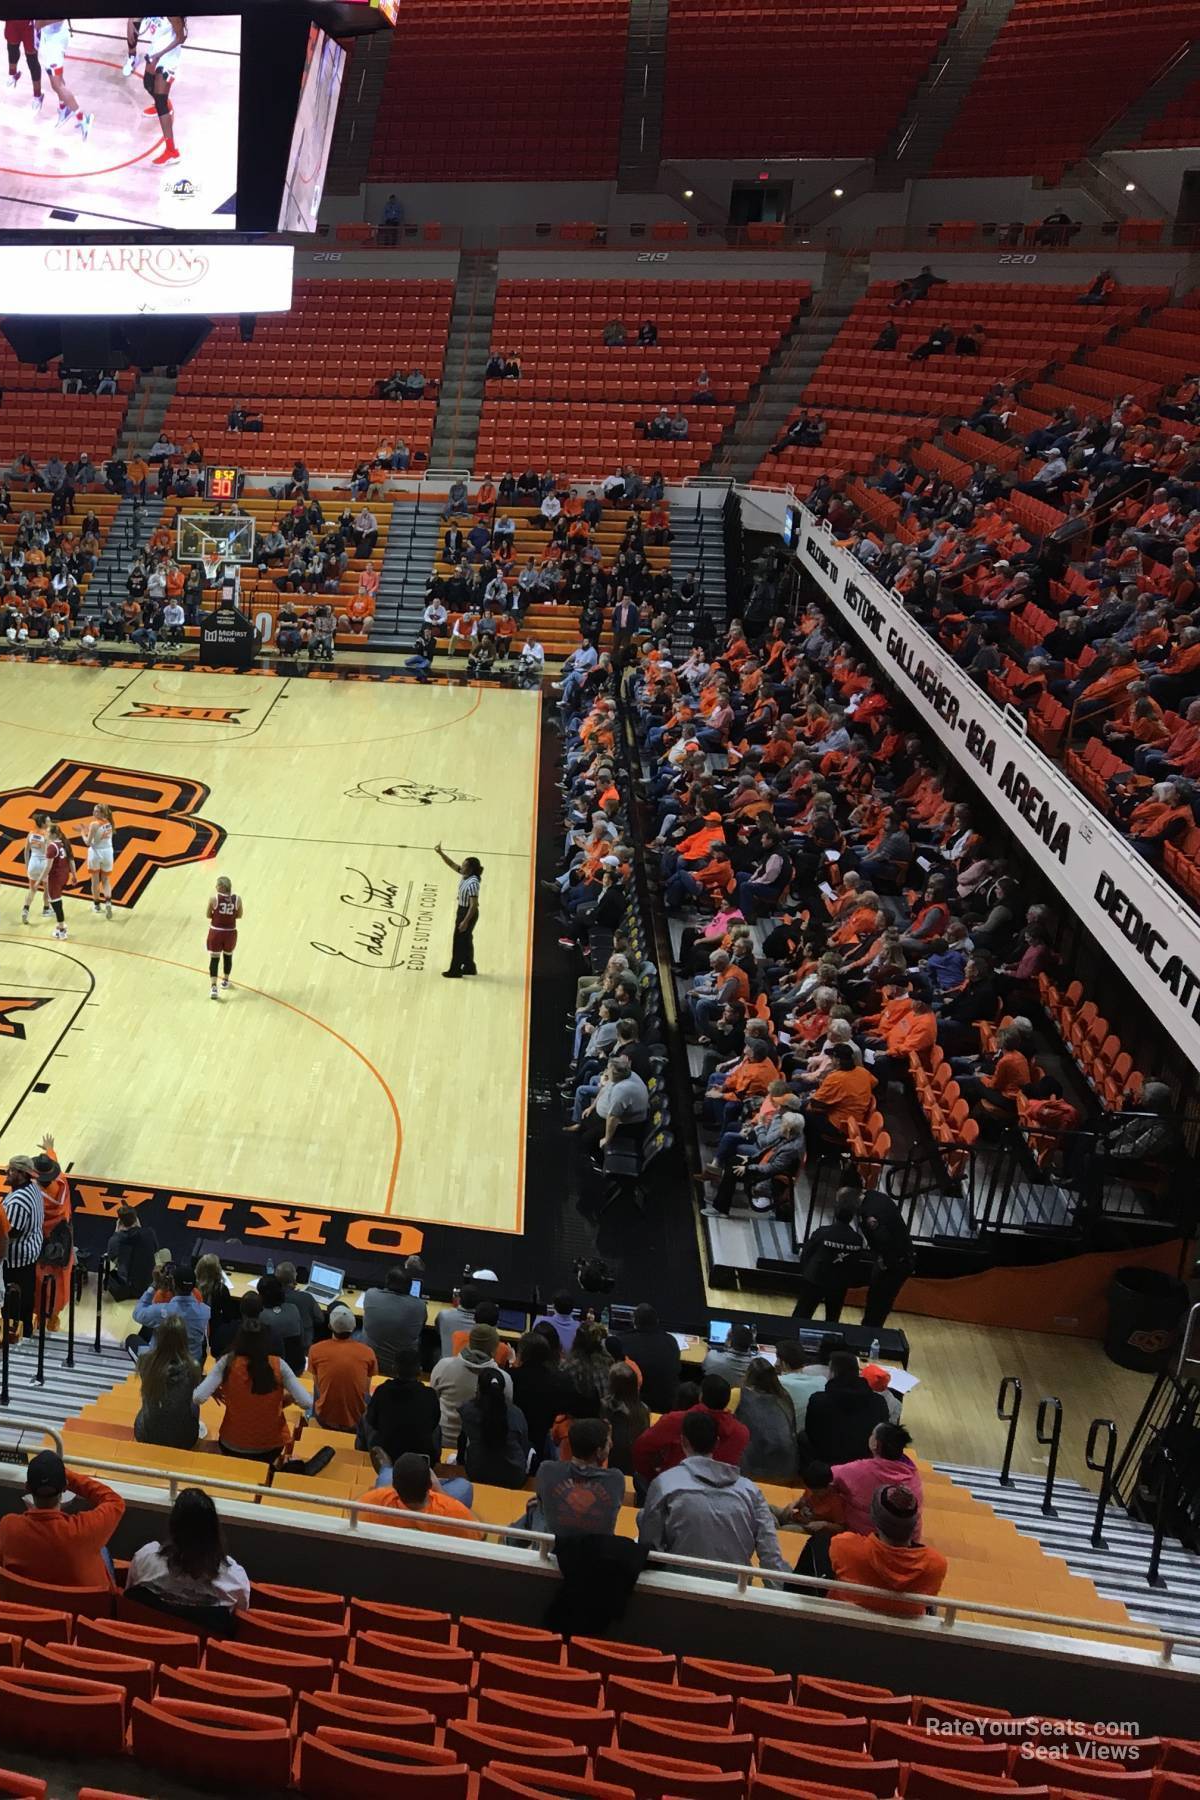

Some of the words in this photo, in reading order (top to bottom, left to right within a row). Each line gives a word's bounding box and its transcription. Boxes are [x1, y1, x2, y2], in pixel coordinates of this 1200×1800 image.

[313, 252, 342, 261] 218
[637, 252, 669, 262] 219
[998, 253, 1036, 264] 220
[44, 248, 209, 287] CIMARRON
[214, 469, 234, 480] 8:52
[212, 480, 232, 496] 30
[806, 536, 830, 575] WELCOME
[829, 566, 838, 584] TO
[843, 578, 886, 643] HISTORIC
[997, 761, 1072, 866] ARENA
[419, 883, 440, 908] COURT
[218, 902, 235, 915] 32
[413, 911, 434, 946] SUTTON
[406, 945, 428, 972] EDDIE
